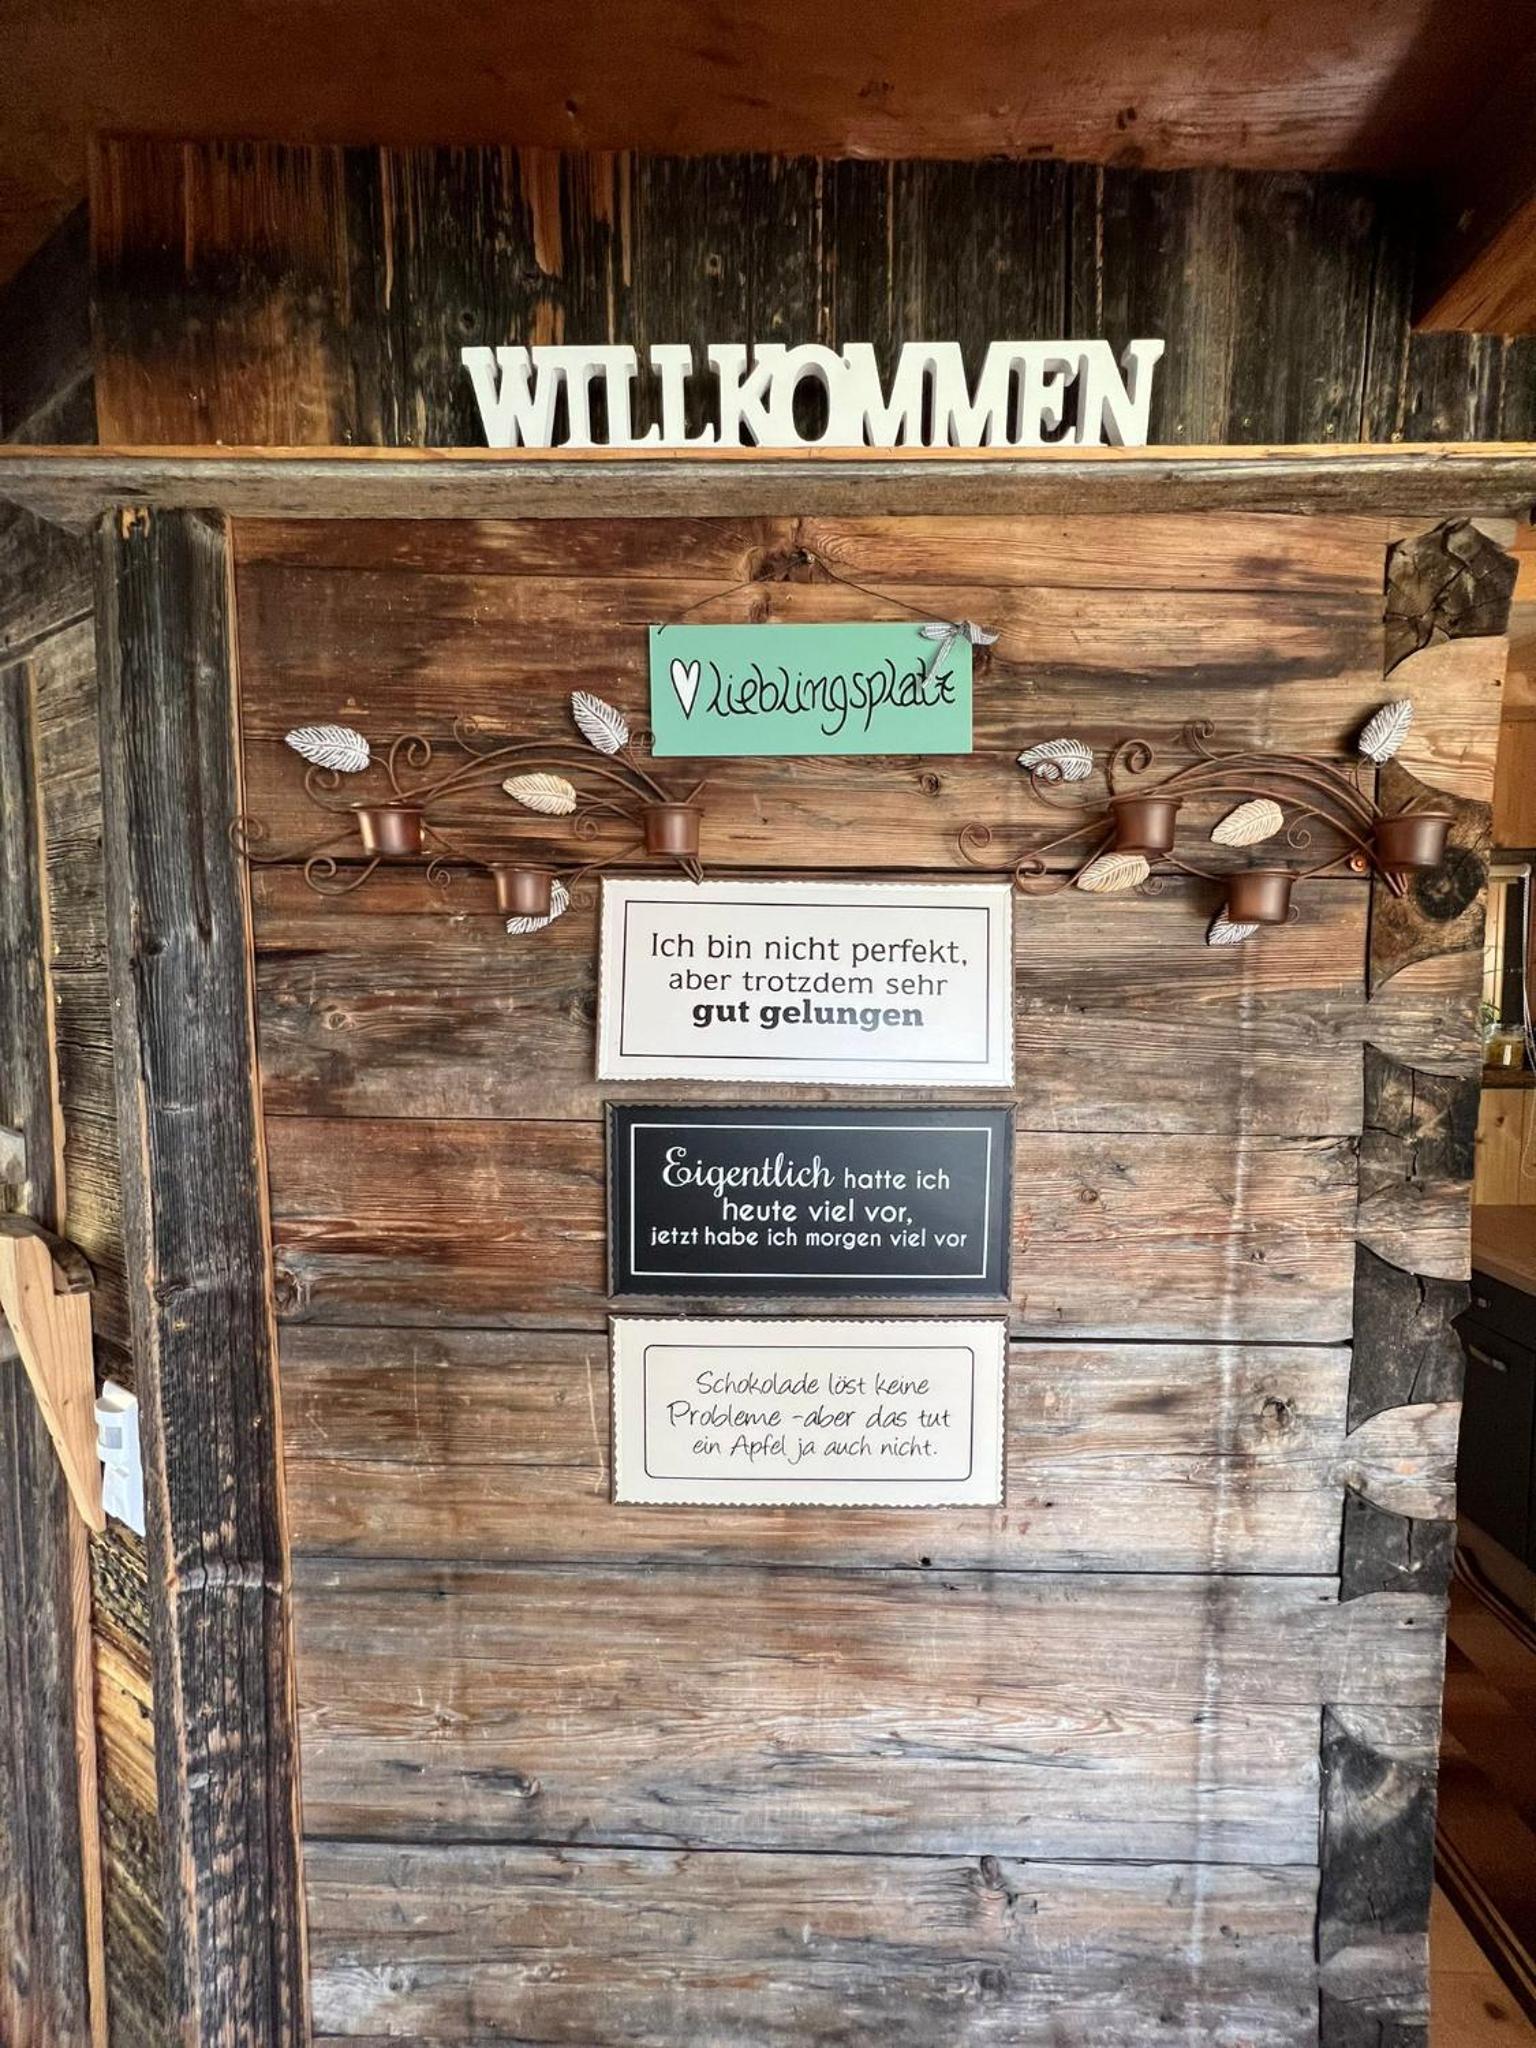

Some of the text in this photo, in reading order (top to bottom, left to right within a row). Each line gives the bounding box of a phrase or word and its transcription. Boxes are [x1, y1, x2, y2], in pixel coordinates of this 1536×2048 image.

[461, 339, 1165, 448] WILLKOMMEN
[651, 932, 968, 968] Ich bin nicht perfekt,
[668, 969, 949, 997] aber trotzdem sehr
[692, 999, 924, 1032] gut gelungen
[661, 1145, 950, 1199] Eigentlich hatte ich
[722, 1197, 914, 1226] heute viel vor,
[650, 1225, 967, 1250] jetzt habe ich morgen viel vor
[695, 1369, 930, 1396] Schokolade löst keine
[666, 1399, 782, 1428] Probleme
[865, 1405, 908, 1428] das
[917, 1408, 952, 1428] tut
[691, 1434, 938, 1465] ein Apfel ja auch nicht.
